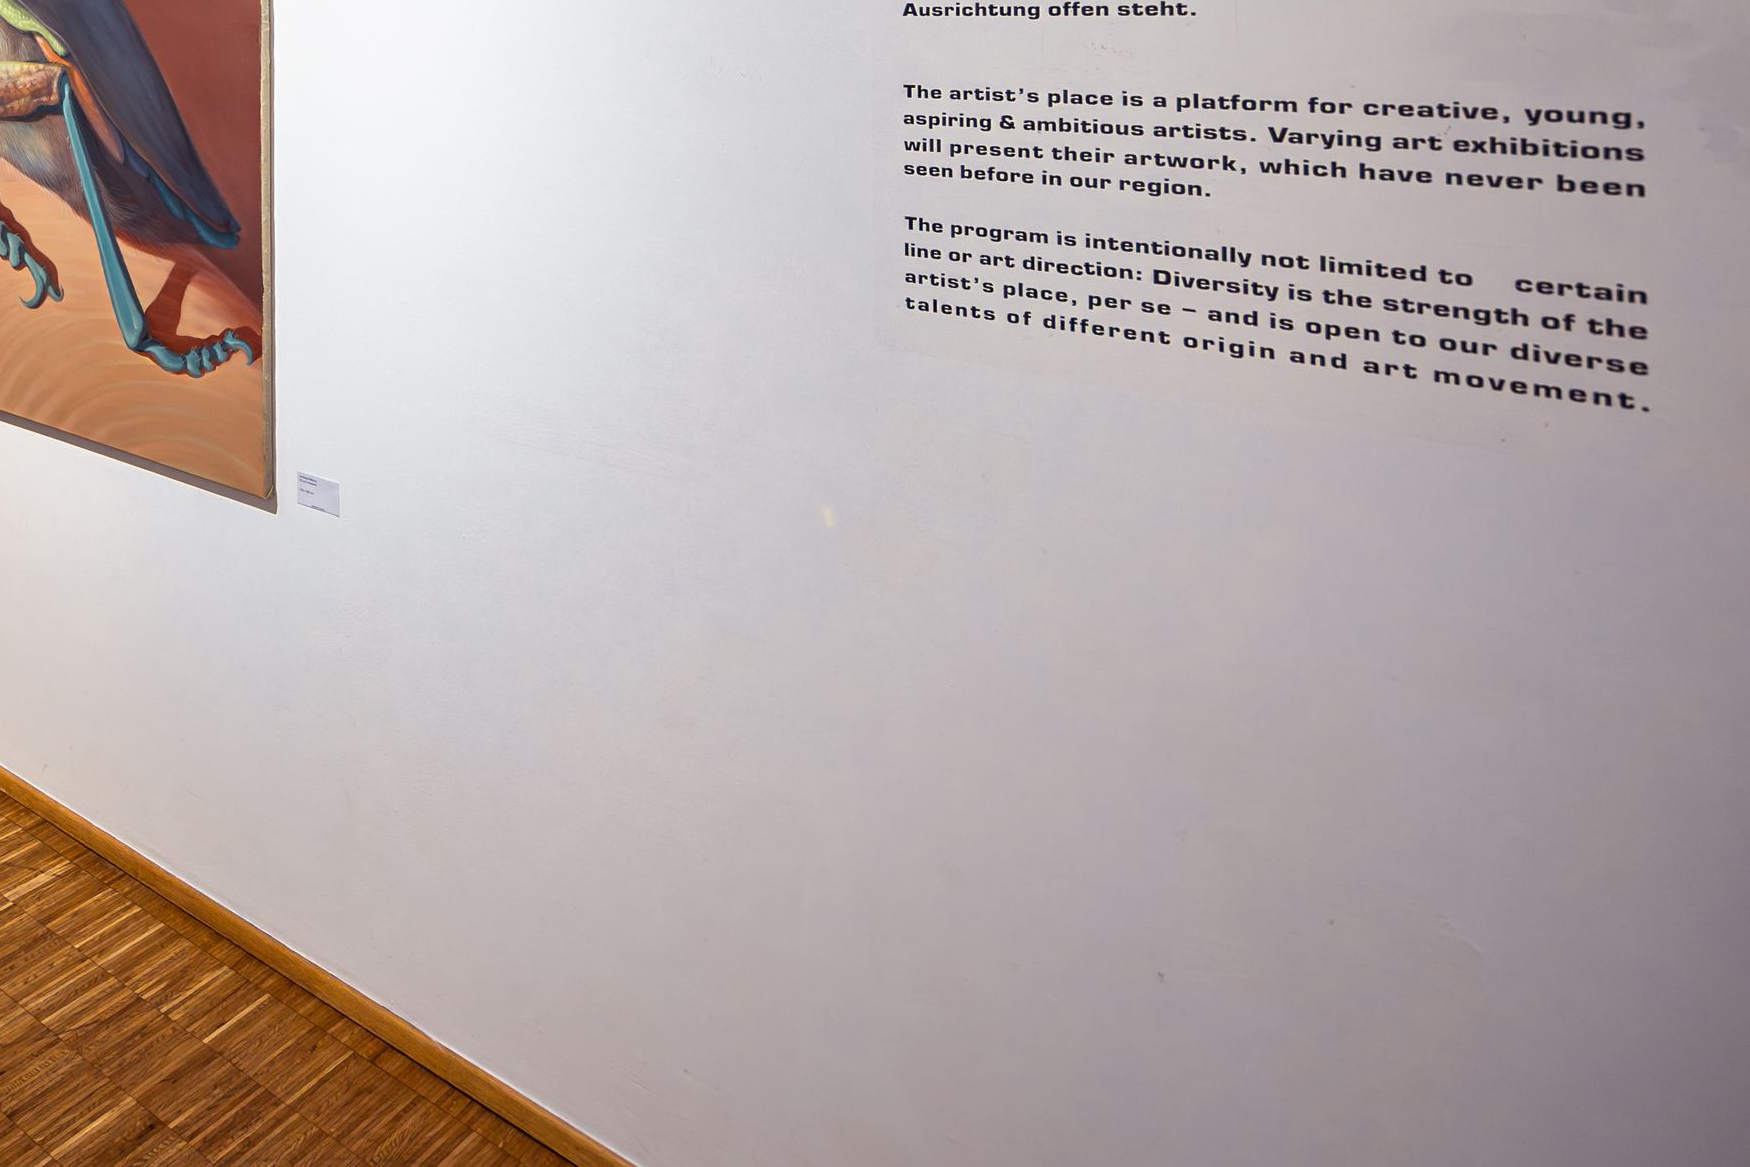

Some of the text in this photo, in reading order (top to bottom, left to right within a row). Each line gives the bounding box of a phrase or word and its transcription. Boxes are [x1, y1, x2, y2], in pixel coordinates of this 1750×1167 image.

[902, 0, 1197, 21] Ausrichtung offen steht.
[902, 83, 1645, 130] The artist's place is a platform for creative, young,
[903, 111, 1645, 162] aspiring & ambitious artists. Varying art exhibitions
[903, 137, 1646, 198] will present their artwork, which have never been
[903, 164, 1211, 198] seen before in our region.
[904, 215, 1648, 305] The program is intentionally not limited to certain
[904, 242, 1649, 341] line or art direction: Diversity is the strength of the
[904, 272, 995, 294] artist's
[1002, 282, 1077, 307] place,
[1088, 294, 1132, 311] per
[1140, 301, 1171, 316] se
[1207, 309, 1259, 327] and
[1269, 312, 1295, 331] is
[1305, 321, 1381, 343] open
[1391, 329, 1427, 348] to
[1438, 337, 1498, 357] our
[1510, 342, 1649, 376] diverse
[904, 296, 1650, 413] talents of different origin and art movement.
